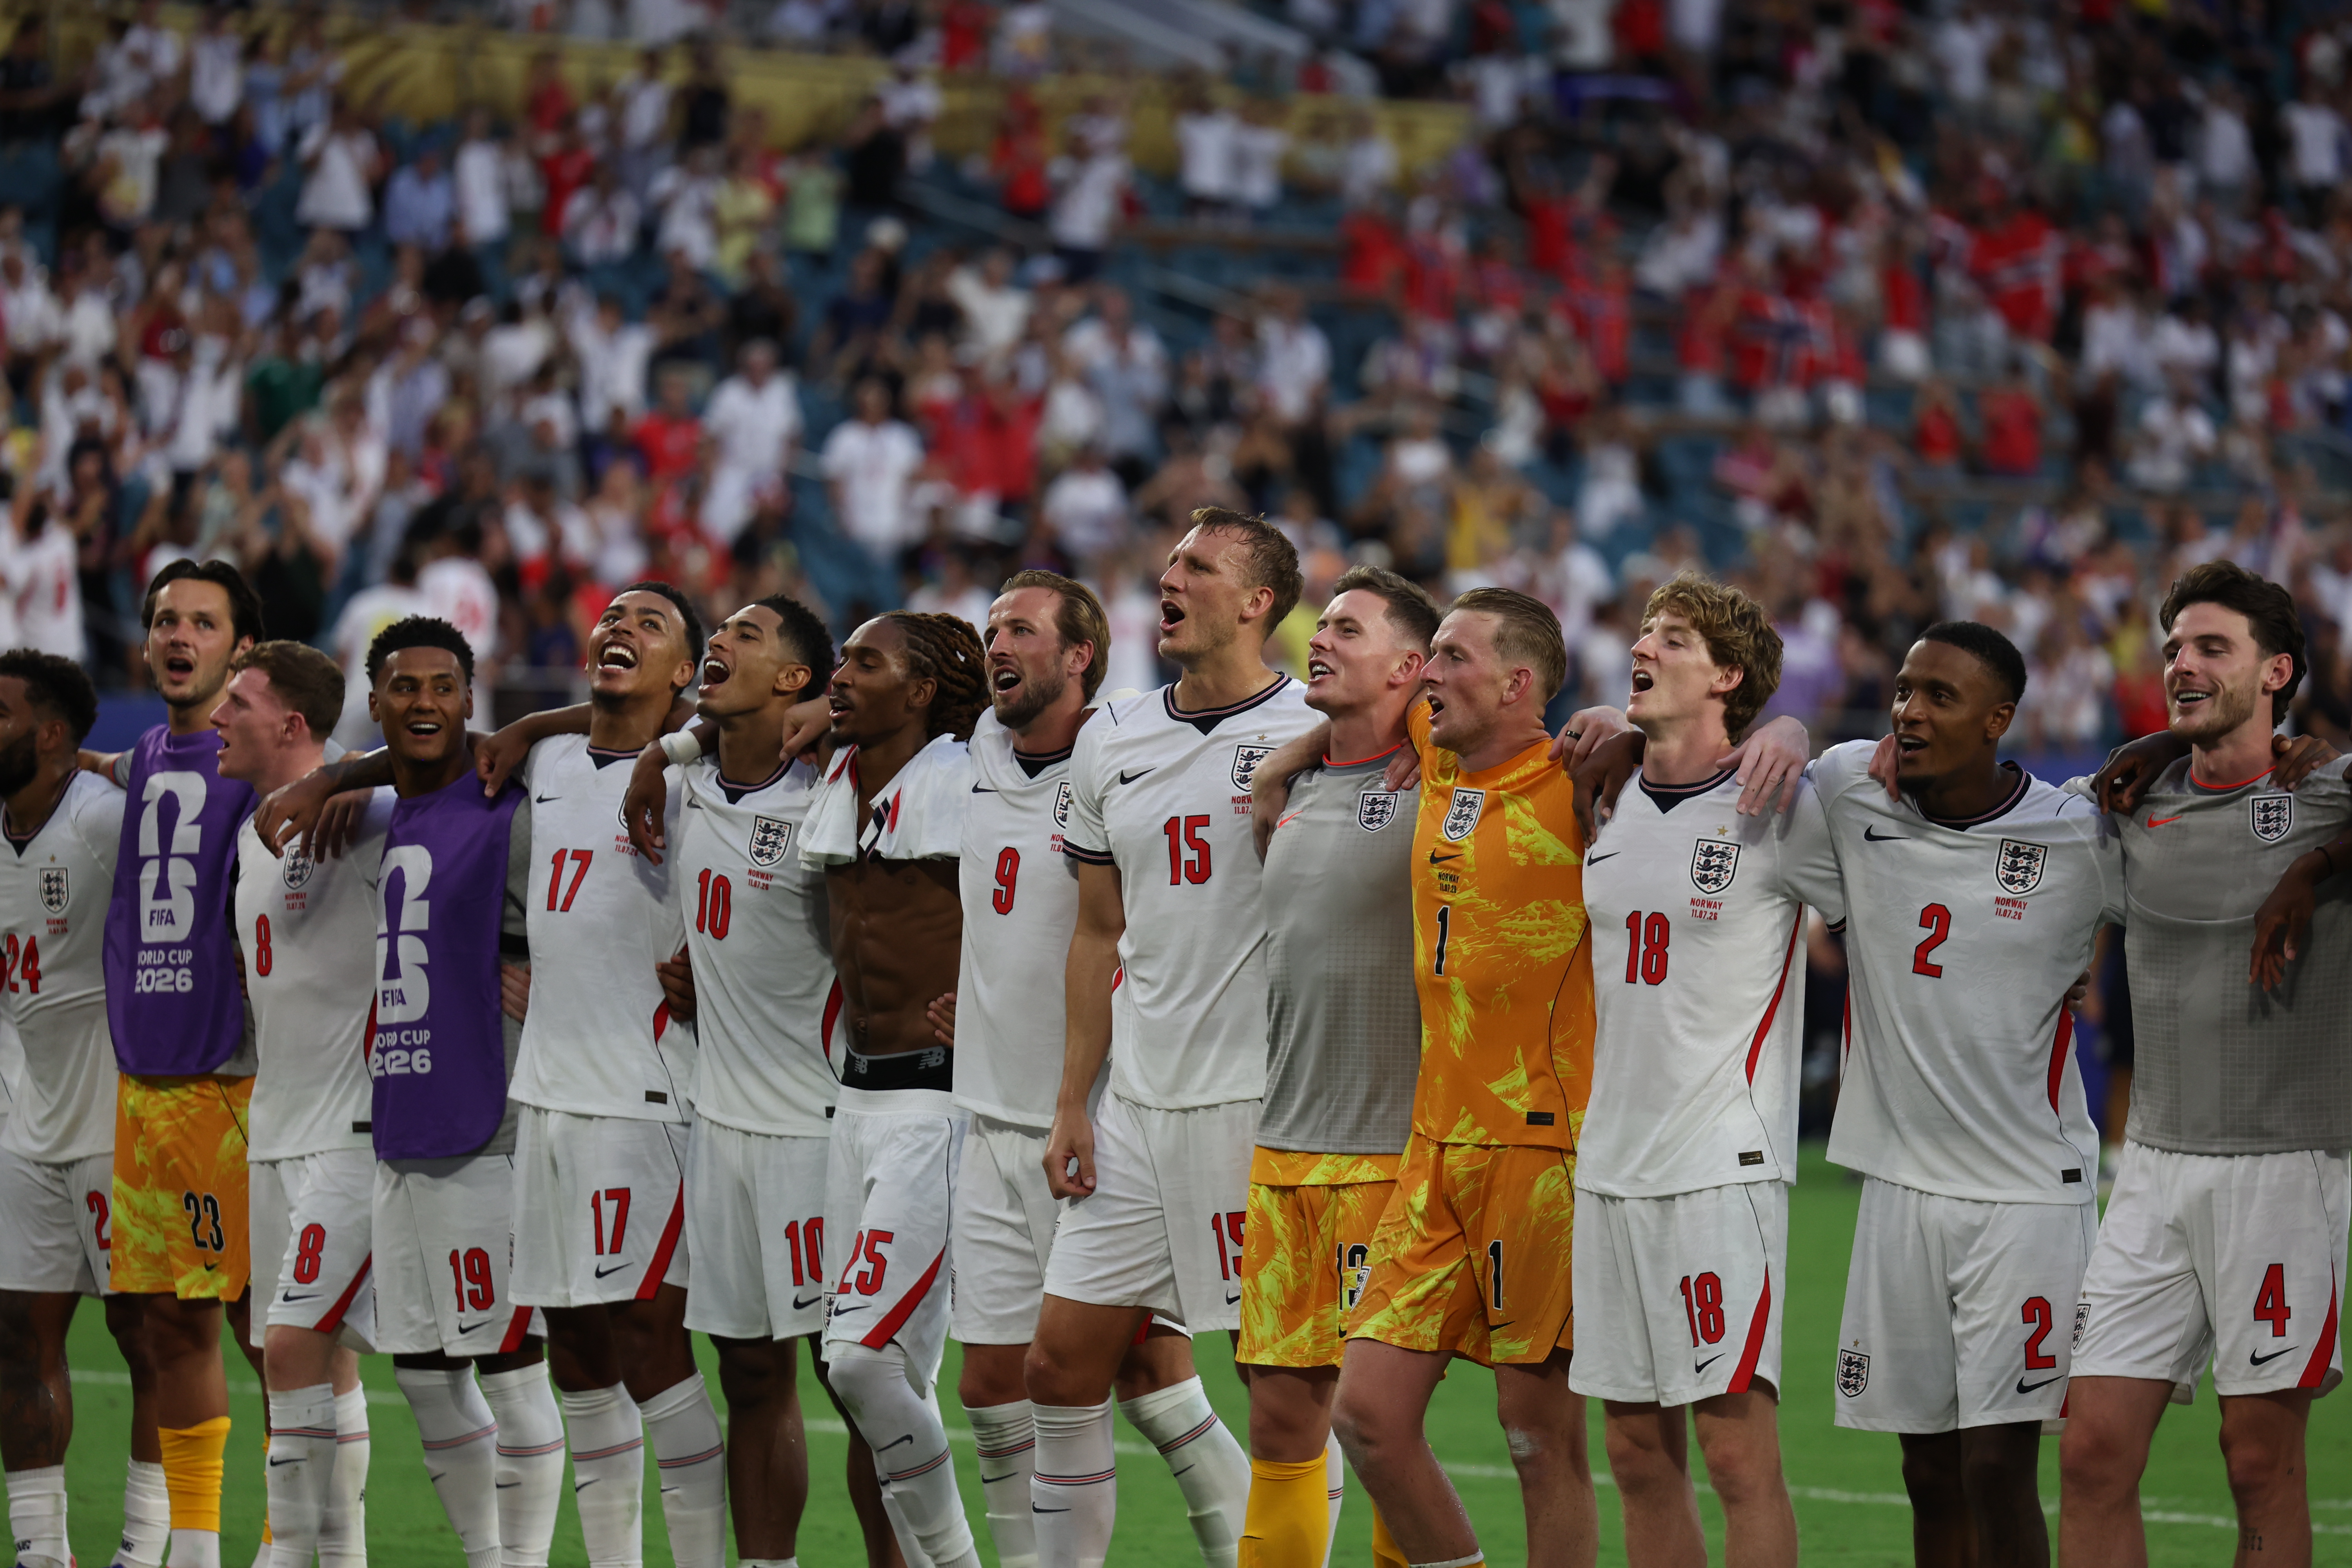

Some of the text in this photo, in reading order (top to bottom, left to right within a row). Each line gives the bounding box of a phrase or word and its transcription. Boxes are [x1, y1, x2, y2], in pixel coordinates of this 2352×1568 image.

[1231, 795, 1252, 804] NORW
[1234, 806, 1252, 814] 11.07.
[615, 834, 630, 844] NOR
[1050, 833, 1064, 842] NOR
[1164, 815, 1212, 886] 15
[547, 848, 593, 912] 17
[696, 868, 731, 940] 10
[748, 867, 774, 882] NORWAY
[748, 878, 769, 890] 11.07.26
[993, 846, 1020, 915] 9
[1438, 871, 1460, 883] NORWAY
[1690, 897, 1723, 910] NORWAY
[1994, 896, 2028, 910] NORWAY
[149, 908, 176, 926] FIFA
[1434, 905, 1450, 976] 1
[1691, 909, 1718, 920] 11.07.26
[1912, 903, 1951, 979] 2
[1995, 907, 2022, 920] 11.07.26
[7, 933, 42, 994] 24
[138, 949, 193, 966] ORLD CUP
[256, 914, 272, 976] 8
[1625, 910, 1670, 985] 18
[135, 967, 193, 993] 2026
[400, 1029, 430, 1045] CUP
[86, 1190, 111, 1250] 2
[182, 1190, 226, 1253] 23
[591, 1187, 631, 1255] 17
[293, 1223, 326, 1284] 8
[449, 1247, 495, 1312] 19
[785, 1217, 824, 1286] 10
[1488, 1240, 1503, 1310] 1
[1679, 1272, 1725, 1348] 18
[2253, 1263, 2291, 1337] 4
[2022, 1296, 2056, 1370] 2
